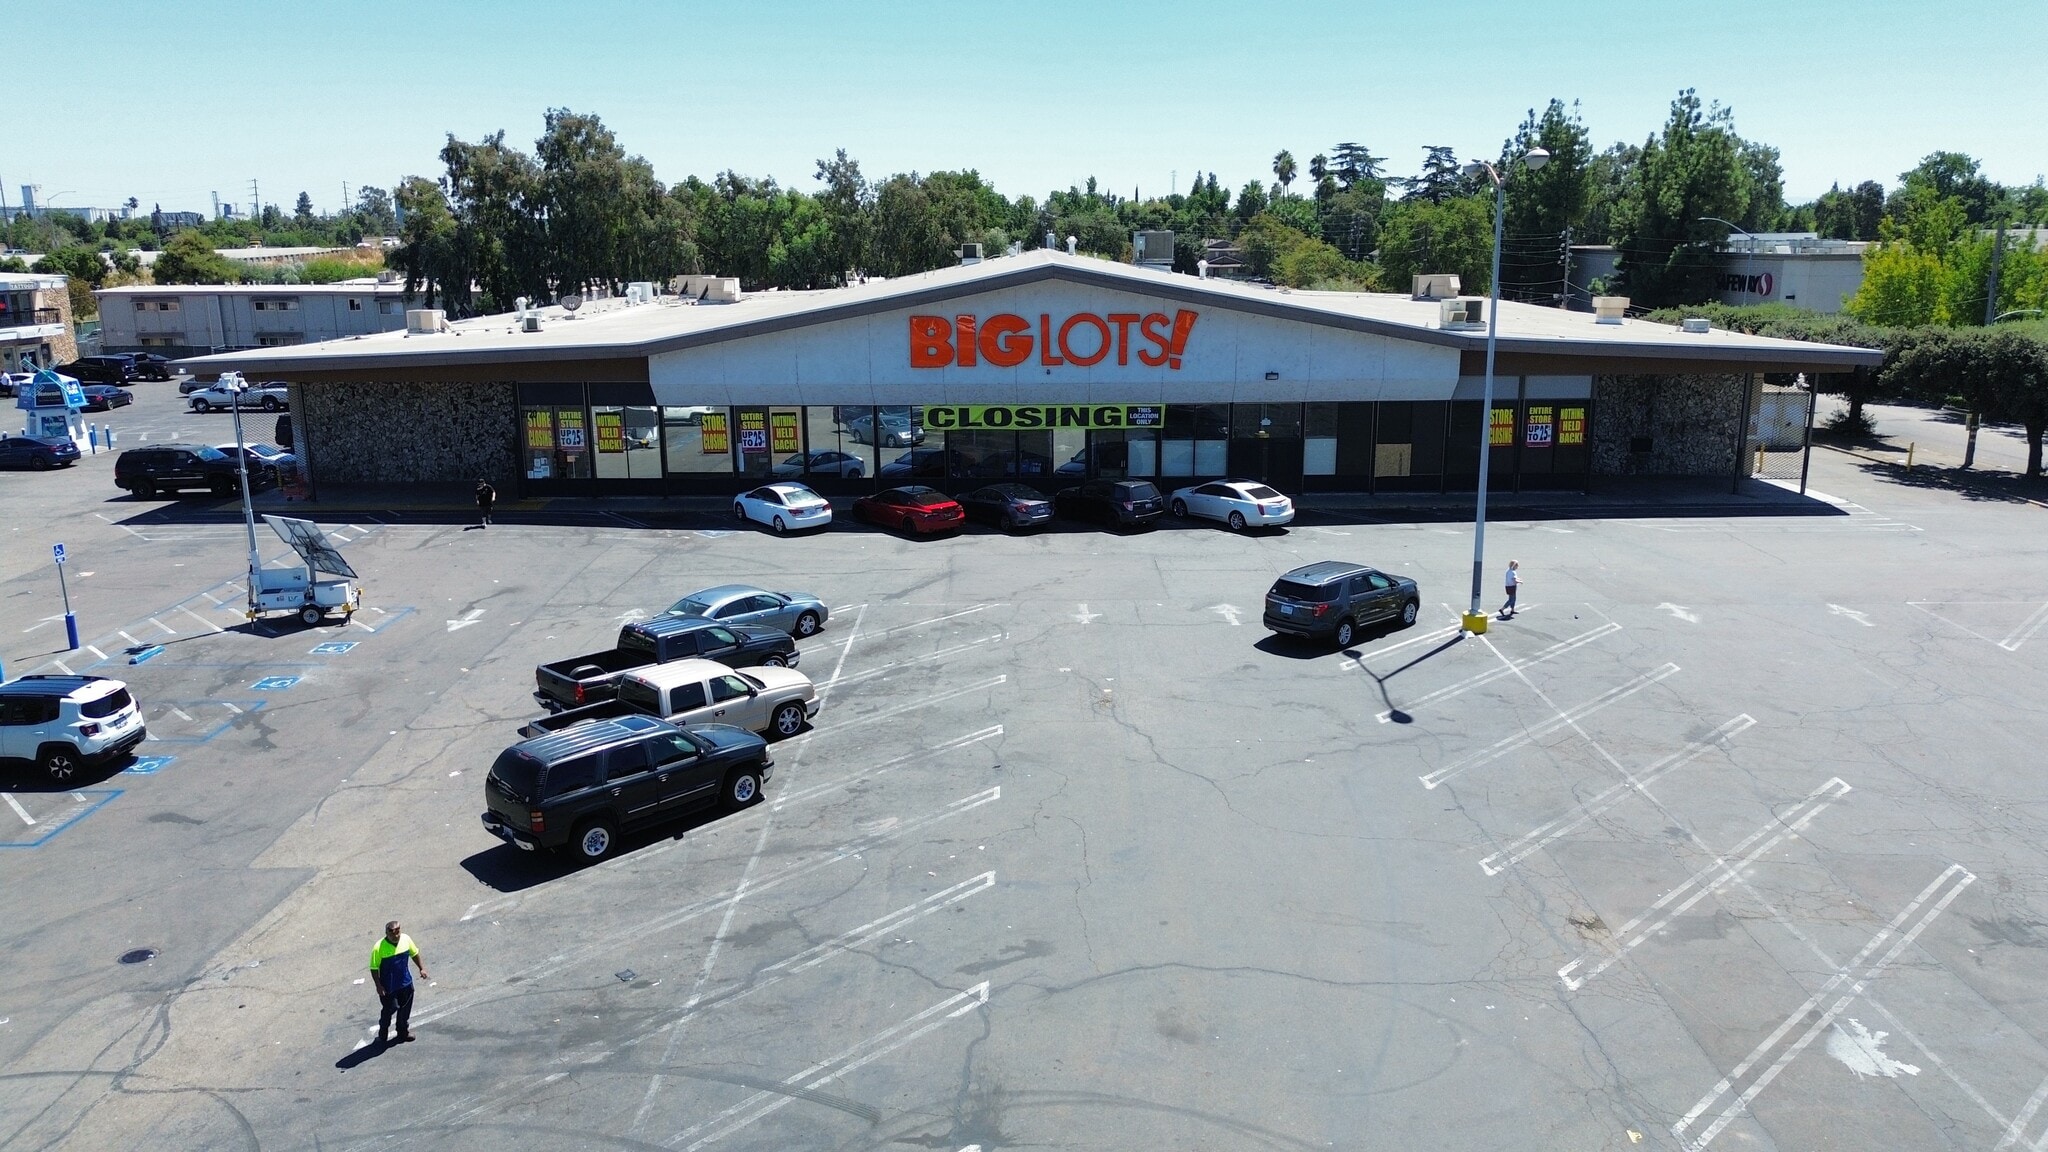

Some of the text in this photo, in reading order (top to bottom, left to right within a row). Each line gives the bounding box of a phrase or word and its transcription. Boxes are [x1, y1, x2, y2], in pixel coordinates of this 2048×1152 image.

[910, 309, 1199, 370] BIG LOTS!
[559, 411, 582, 419] ENTIRE
[1490, 408, 1513, 424] STORE
[1529, 407, 1552, 415] ENTIRE
[1560, 408, 1584, 419] NOTHING
[528, 411, 551, 428] STORE
[597, 415, 621, 426] NOTHING
[772, 415, 796, 427] NOTHING
[927, 406, 1122, 428] CLOSING
[1530, 415, 1551, 424] STORE
[560, 420, 583, 428] STORE
[702, 415, 726, 431] STORE
[742, 421, 764, 429] STORE
[1563, 421, 1580, 431] HELD
[560, 429, 571, 437] UP
[600, 428, 618, 438] HELD
[776, 428, 793, 438] HELD
[1528, 425, 1539, 433] UP
[528, 430, 553, 447] CLOSING
[742, 431, 753, 439] UP
[1528, 433, 1539, 441] TO
[1560, 432, 1582, 443] BACK!
[600, 440, 622, 450] BACK!
[703, 433, 727, 450] CLOSING
[775, 439, 797, 450] BACK!
